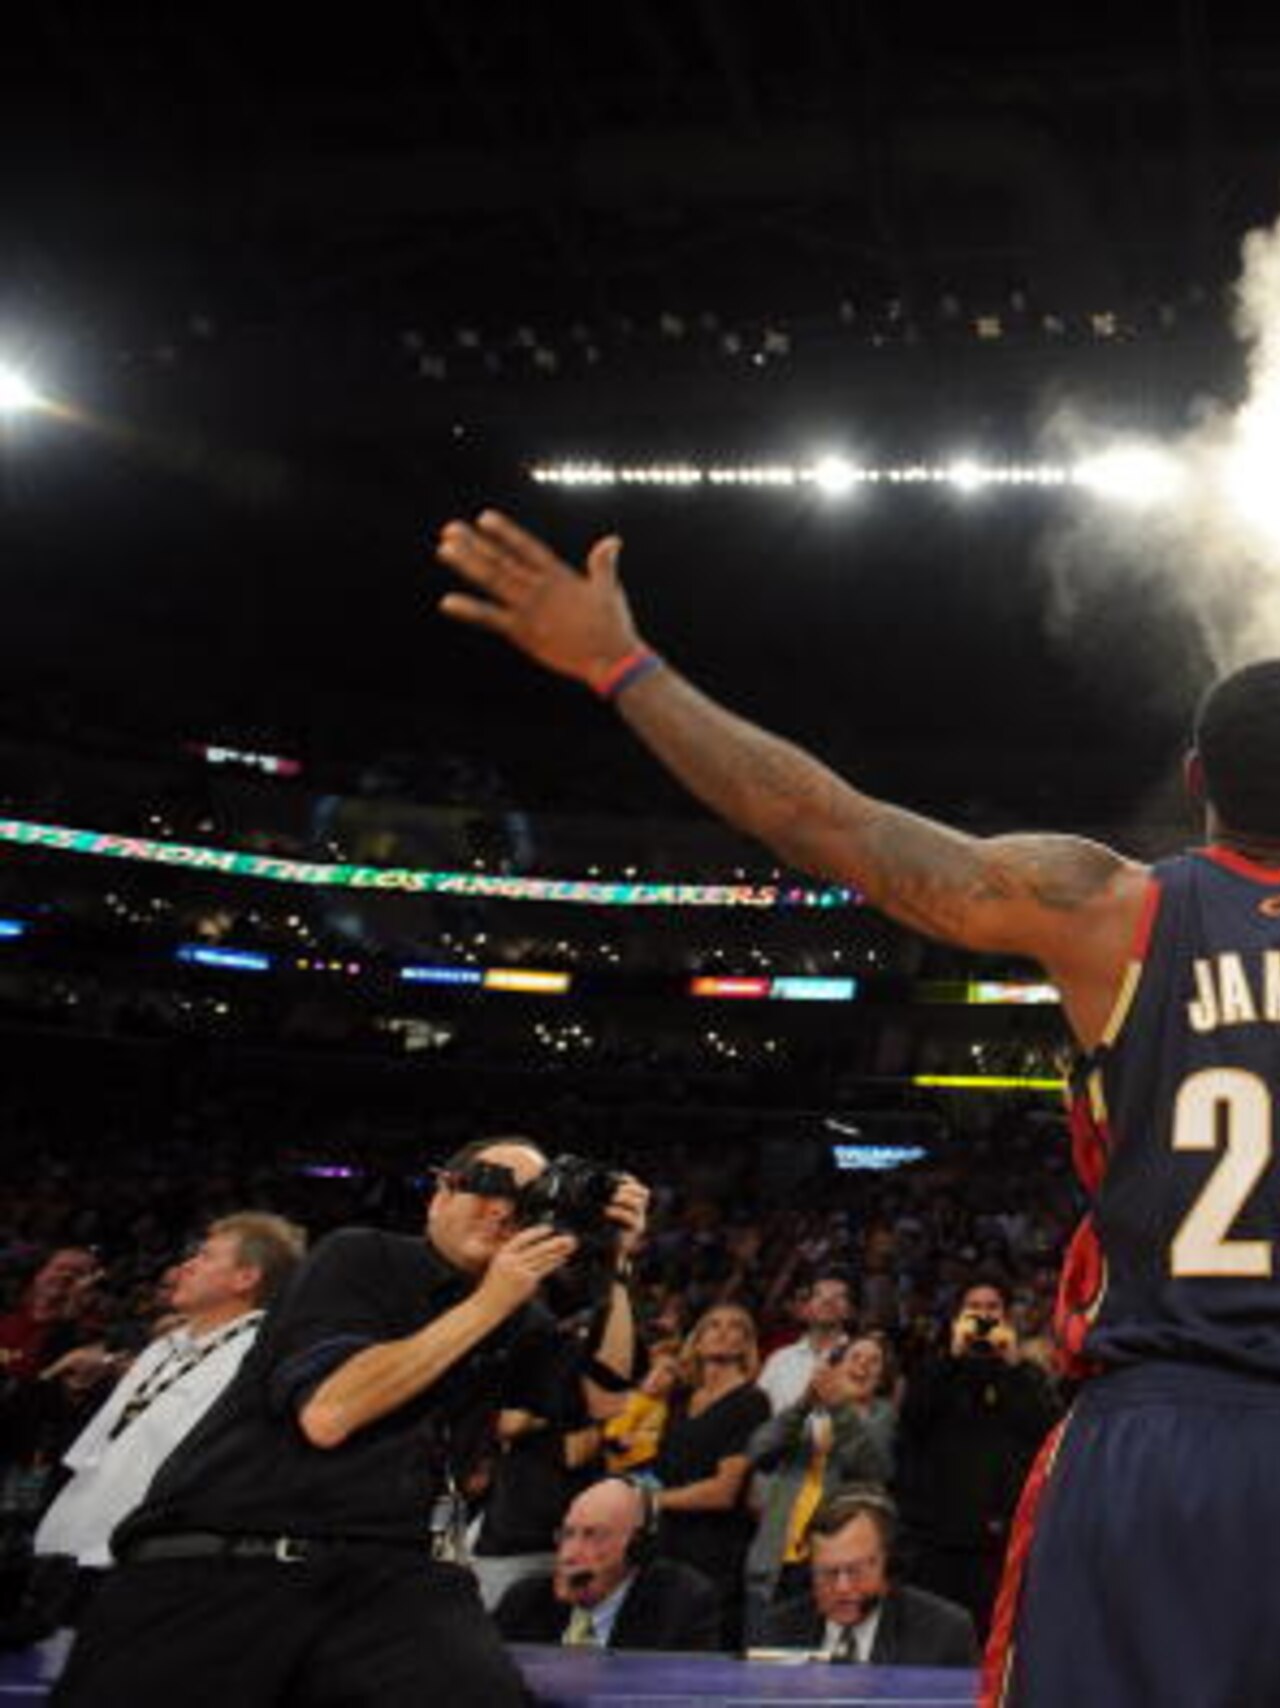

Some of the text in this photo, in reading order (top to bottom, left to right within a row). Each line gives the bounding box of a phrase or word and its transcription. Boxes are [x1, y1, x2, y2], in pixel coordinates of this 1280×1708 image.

[91, 833, 237, 873] FROM
[249, 856, 340, 886] THE
[349, 867, 424, 892] LOS
[628, 884, 778, 907] LAKERS
